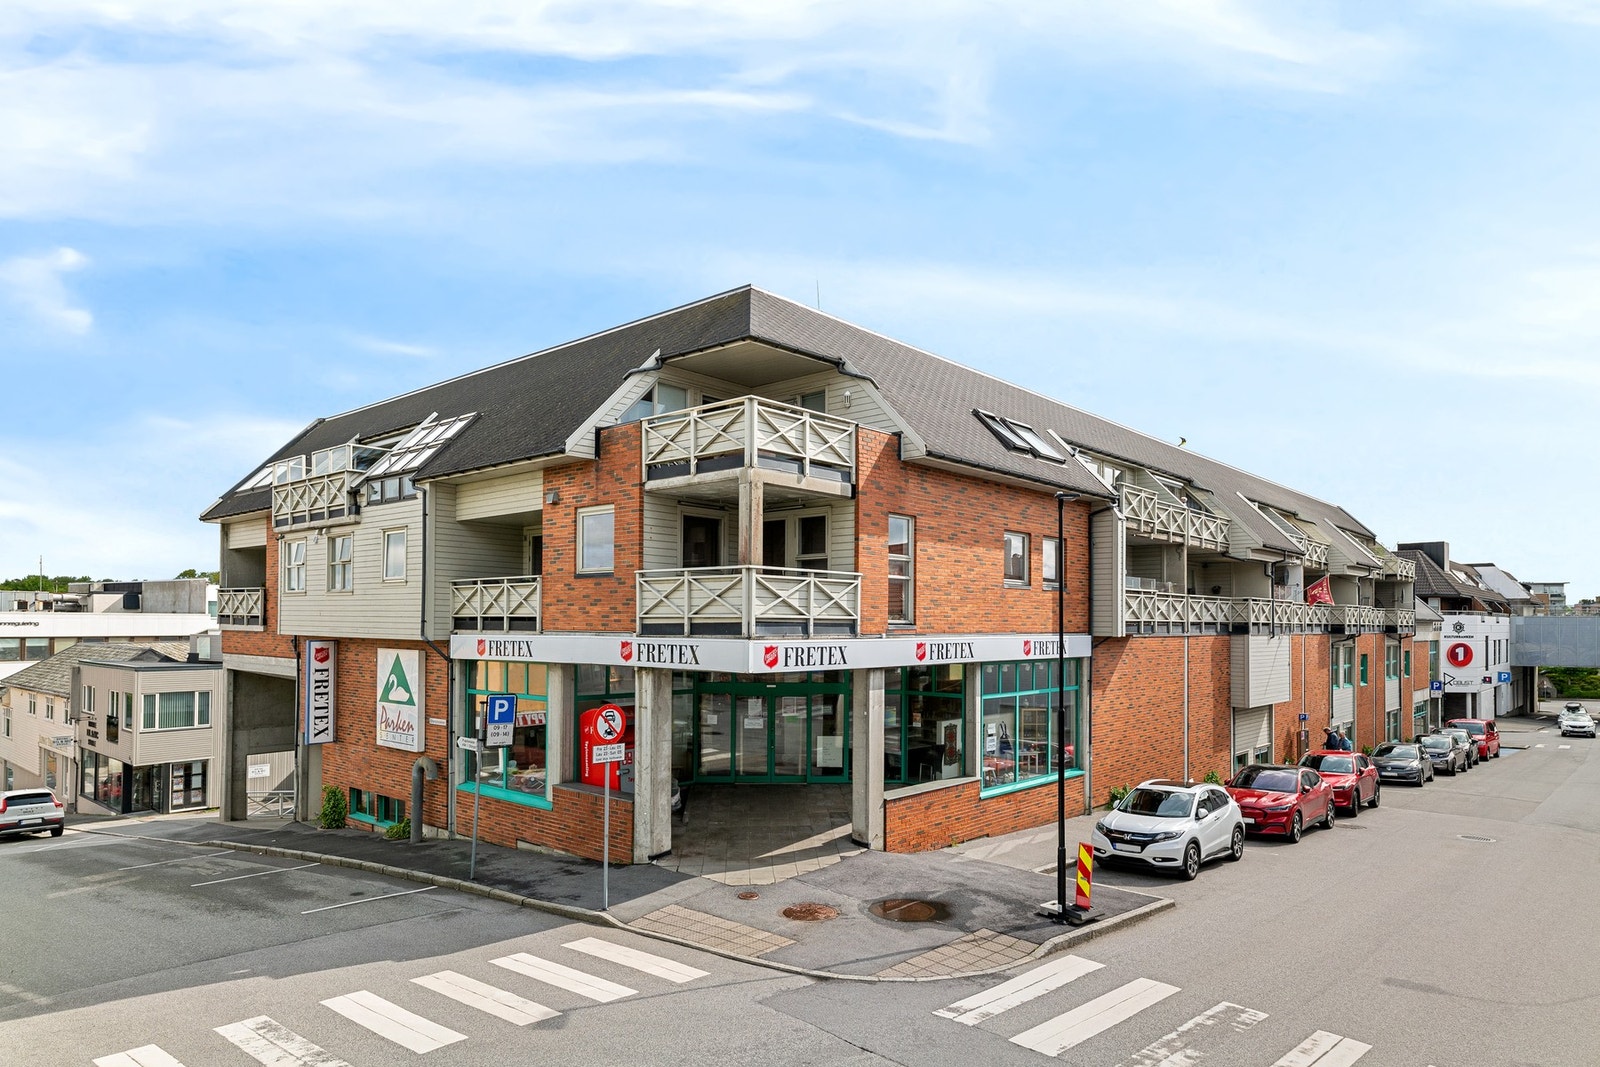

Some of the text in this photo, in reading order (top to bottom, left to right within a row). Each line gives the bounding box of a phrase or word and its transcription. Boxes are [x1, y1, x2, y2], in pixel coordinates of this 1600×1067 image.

[488, 640, 533, 657] FRETEX
[637, 643, 700, 665] FRETEX
[783, 646, 848, 667] FRETEX
[929, 642, 974, 660] FRETEX
[1433, 682, 1440, 690] P
[313, 667, 330, 738] FRETEX
[494, 699, 509, 720] P
[380, 705, 415, 733] Parken
[379, 732, 415, 743] SENTER
